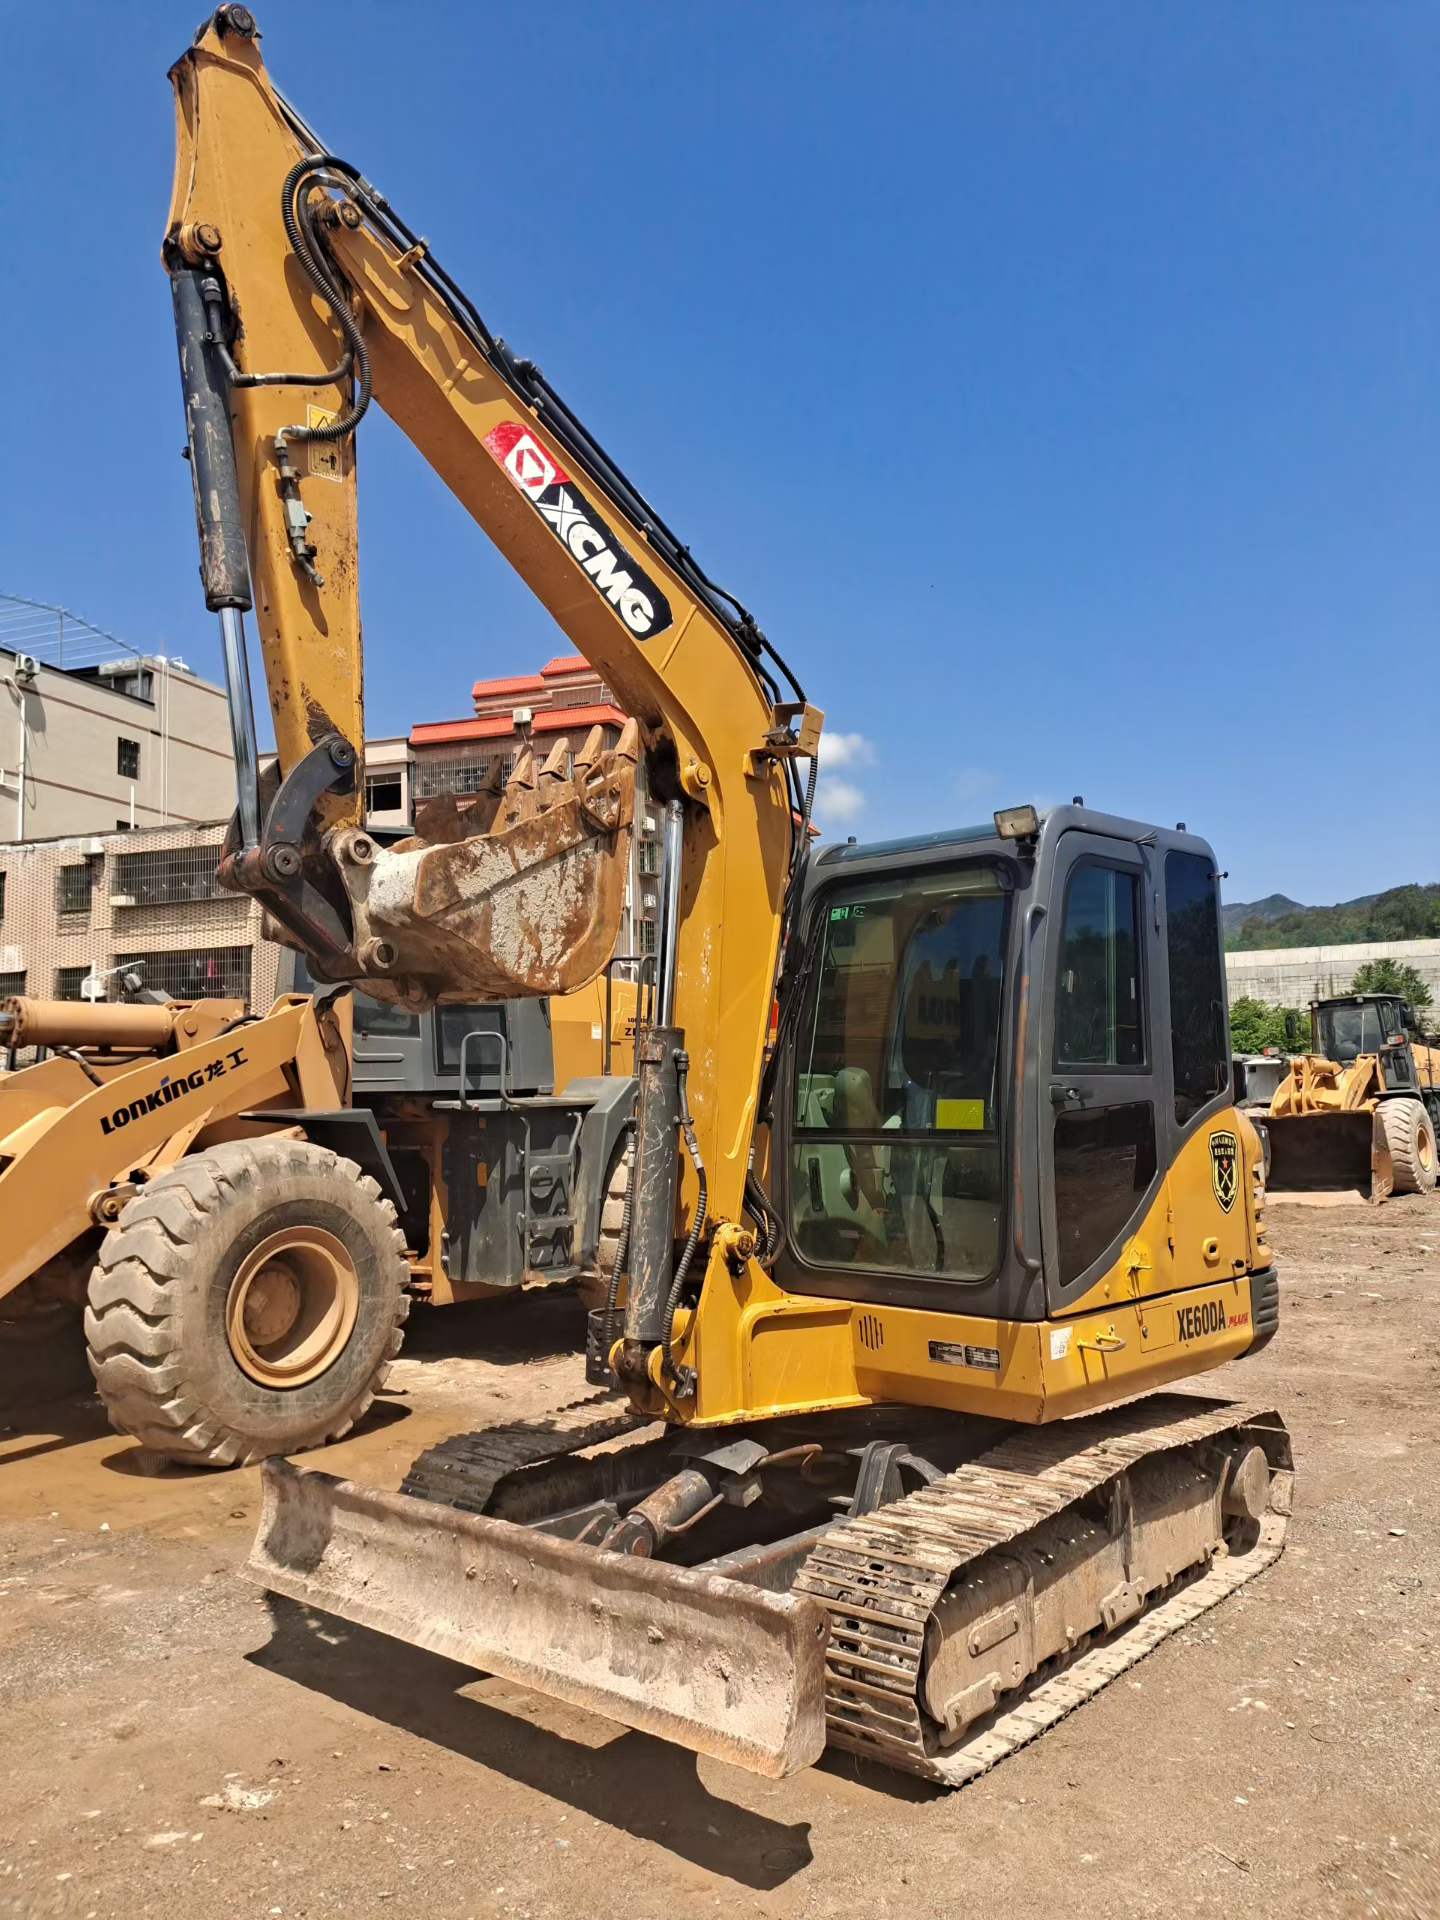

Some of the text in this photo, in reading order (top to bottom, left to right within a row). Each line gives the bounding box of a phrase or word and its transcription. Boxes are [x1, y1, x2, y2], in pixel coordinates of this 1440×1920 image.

[535, 486, 654, 633] XCMG
[99, 1047, 248, 1135] LONKING 龙工
[1177, 1300, 1226, 1342] XE60DA
